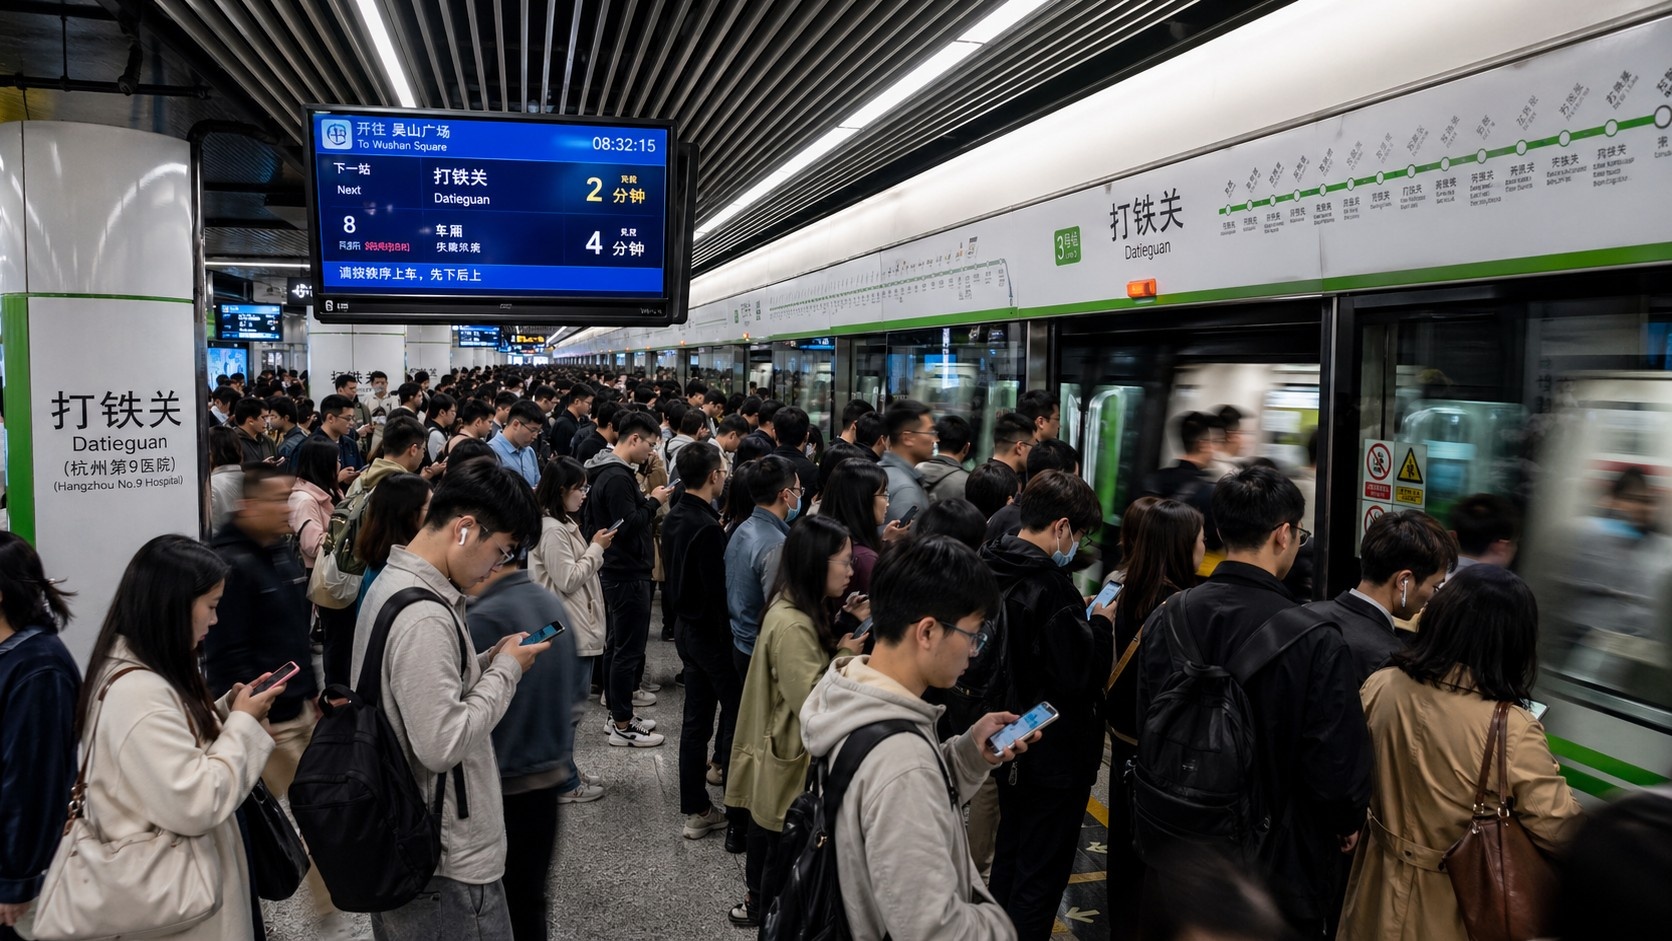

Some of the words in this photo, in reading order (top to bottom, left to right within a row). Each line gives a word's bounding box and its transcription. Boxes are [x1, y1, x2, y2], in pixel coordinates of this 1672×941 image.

[356, 121, 387, 137] 开往
[357, 139, 370, 149] To
[372, 140, 412, 150] Wushan
[414, 141, 448, 152] Square
[592, 136, 656, 152] 08:32:15
[333, 162, 371, 176] 下一站
[433, 167, 488, 187] 打铁关
[337, 185, 362, 195] Next
[586, 176, 603, 202] 2
[612, 187, 646, 204] 分钟
[434, 192, 491, 207] Datieguan
[1109, 187, 1184, 242] 打铁关
[343, 215, 356, 234] 8
[585, 230, 603, 255] 4
[612, 241, 645, 257] 分钟
[1124, 241, 1172, 260] Datieguan
[51, 390, 182, 430] 打铁关
[72, 436, 168, 455] Datieguan
[53, 480, 115, 493] (Hangzhou
[117, 479, 143, 489] No.9
[145, 474, 184, 487] Hospital)
